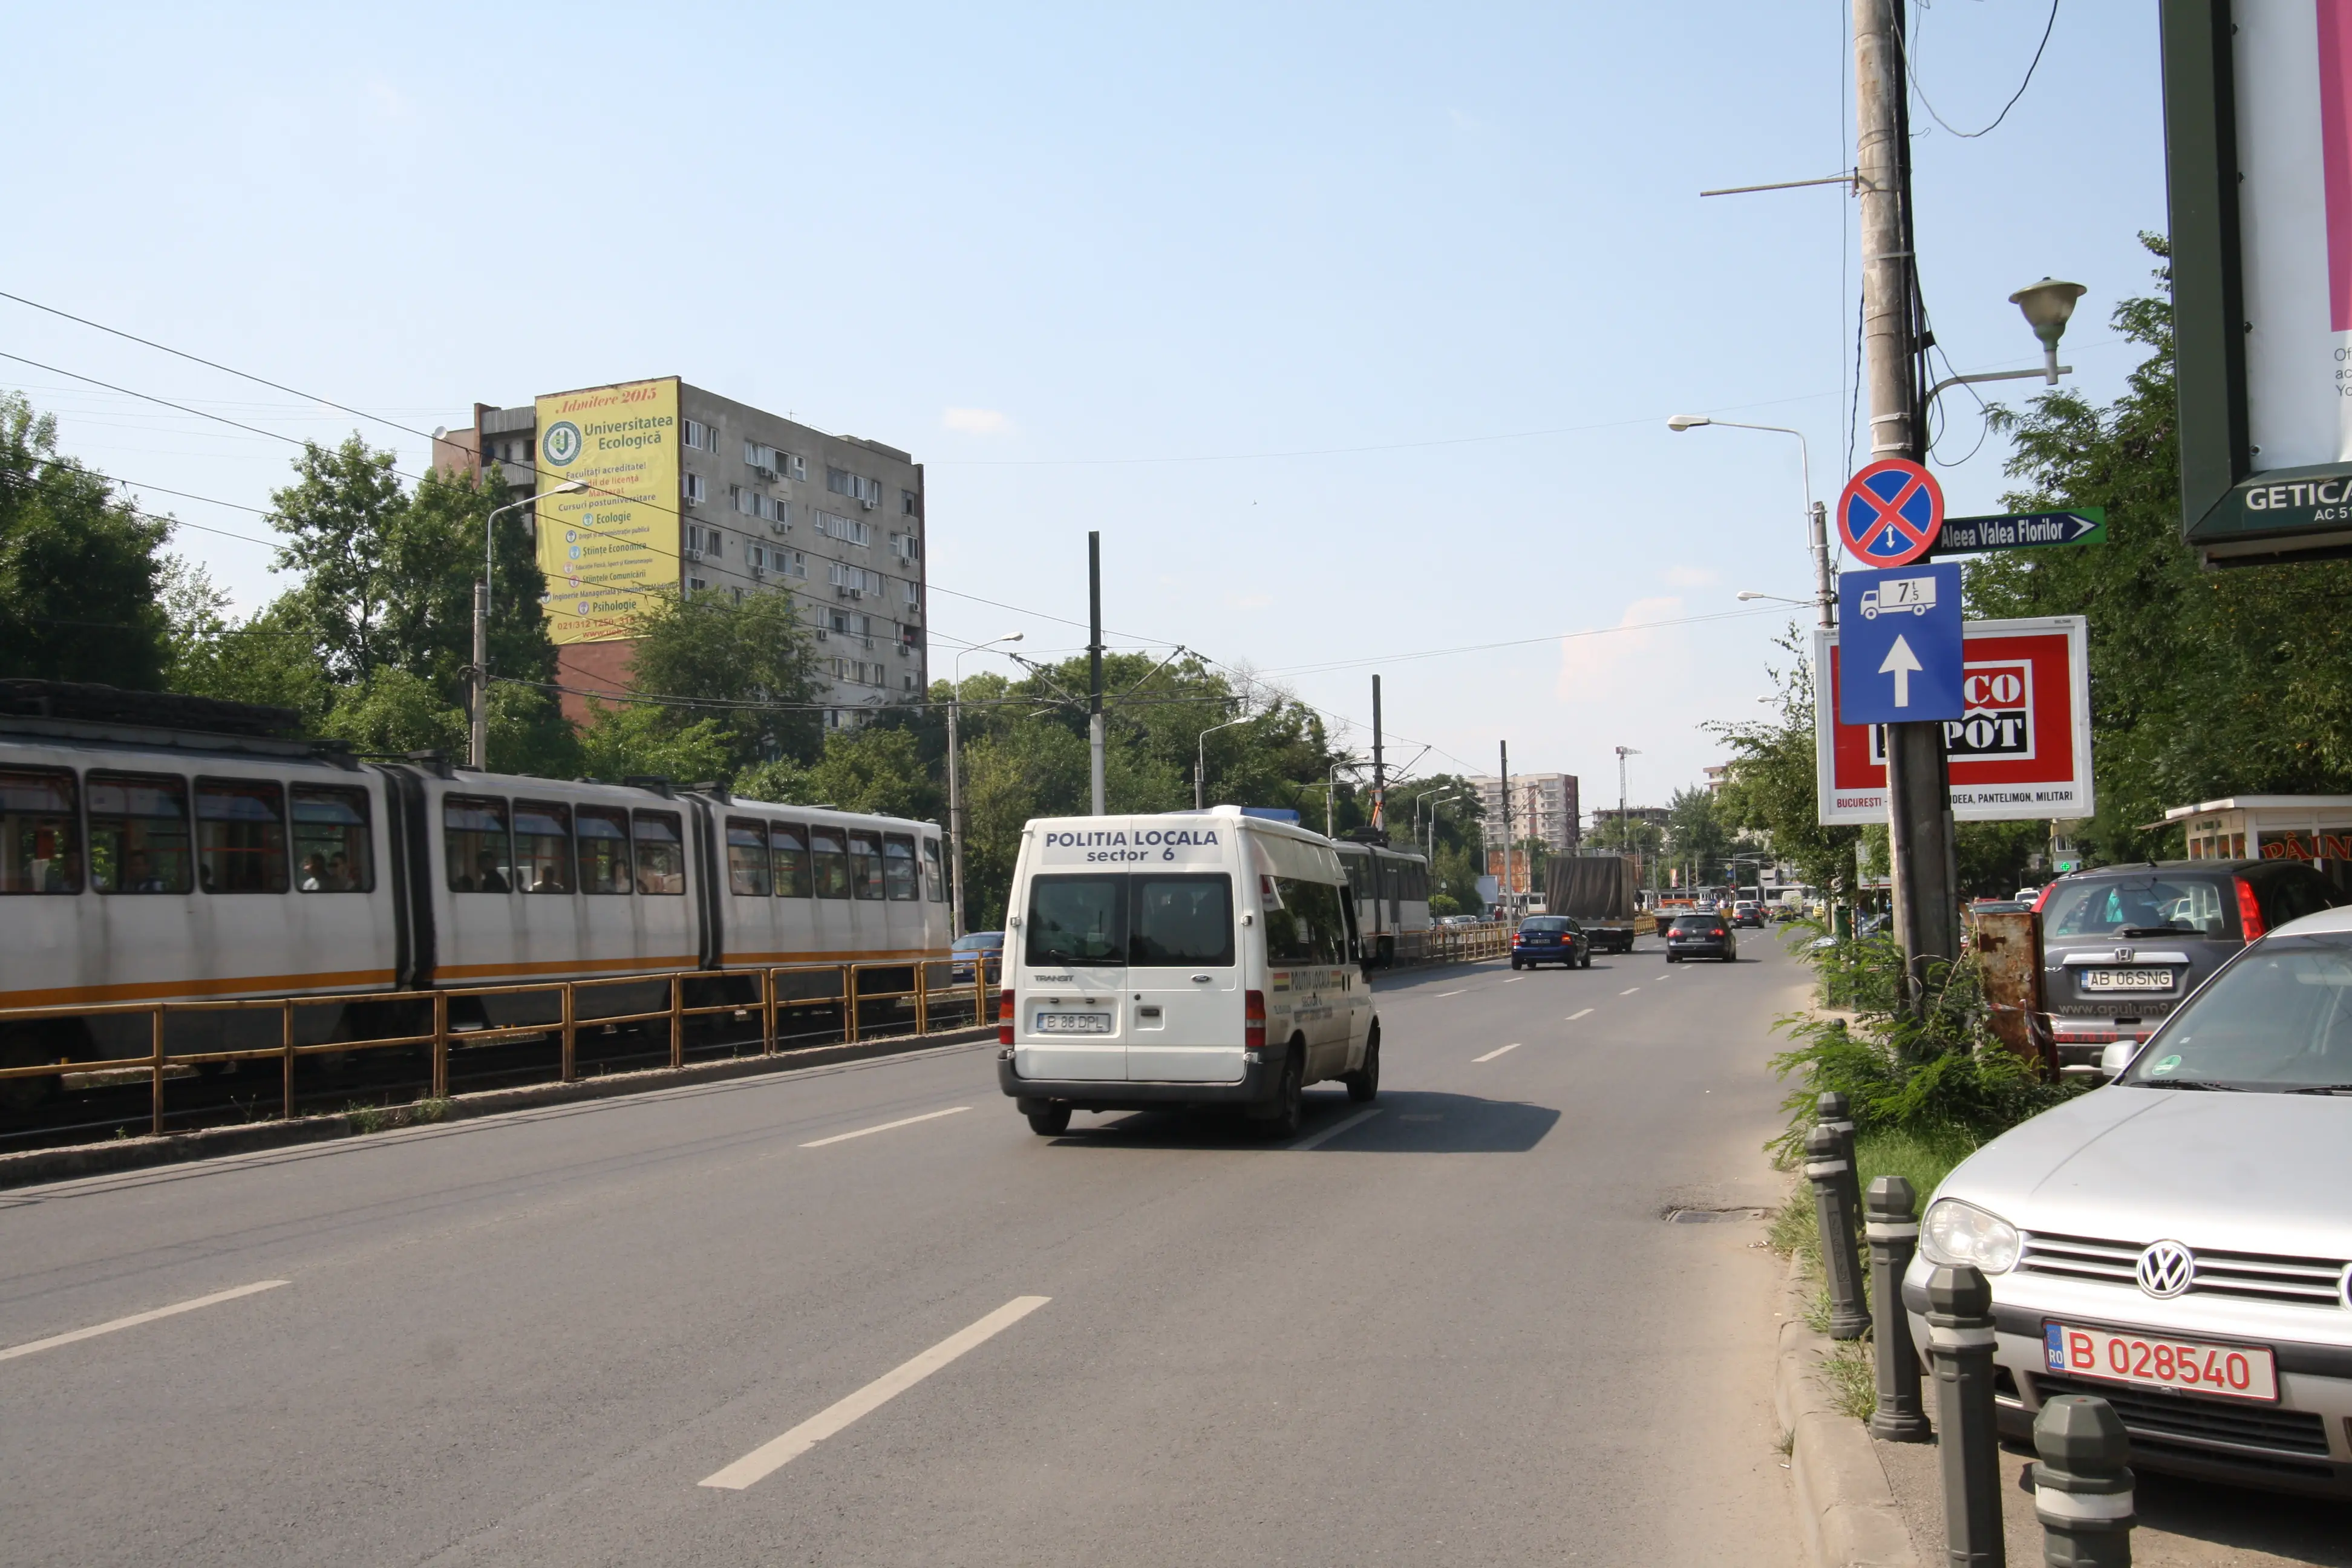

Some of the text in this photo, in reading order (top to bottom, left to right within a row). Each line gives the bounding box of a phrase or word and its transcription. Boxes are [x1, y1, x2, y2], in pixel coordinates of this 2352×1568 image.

[555, 387, 656, 414] Admitere 2015
[584, 416, 673, 436] Universitatea
[599, 430, 661, 450] Ecologică
[603, 462, 646, 474] acreditate!
[612, 474, 639, 486] licență
[558, 494, 656, 511] Cursuri postuniversitare
[596, 511, 631, 524] Ecologie
[2314, 508, 2335, 521] AC
[1941, 518, 2063, 547] Aleea Valea Florilor
[583, 545, 607, 557] Științe
[610, 569, 646, 581] Comunicării
[593, 599, 636, 613] Psihologie
[558, 620, 590, 630] 021/312
[1837, 797, 1881, 808] BUCUREȘTI
[1978, 792, 2033, 803] PANTELIMON,
[2036, 791, 2073, 802] MILITARI
[1046, 831, 1218, 847] POLITIA LOCALA
[1086, 848, 1175, 861] sector 6
[2091, 972, 2110, 986] AB
[1048, 1016, 1056, 1028] B
[1078, 1016, 1103, 1028] DPL
[2048, 1348, 2063, 1364] RO
[2069, 1331, 2250, 1390] B 028540
